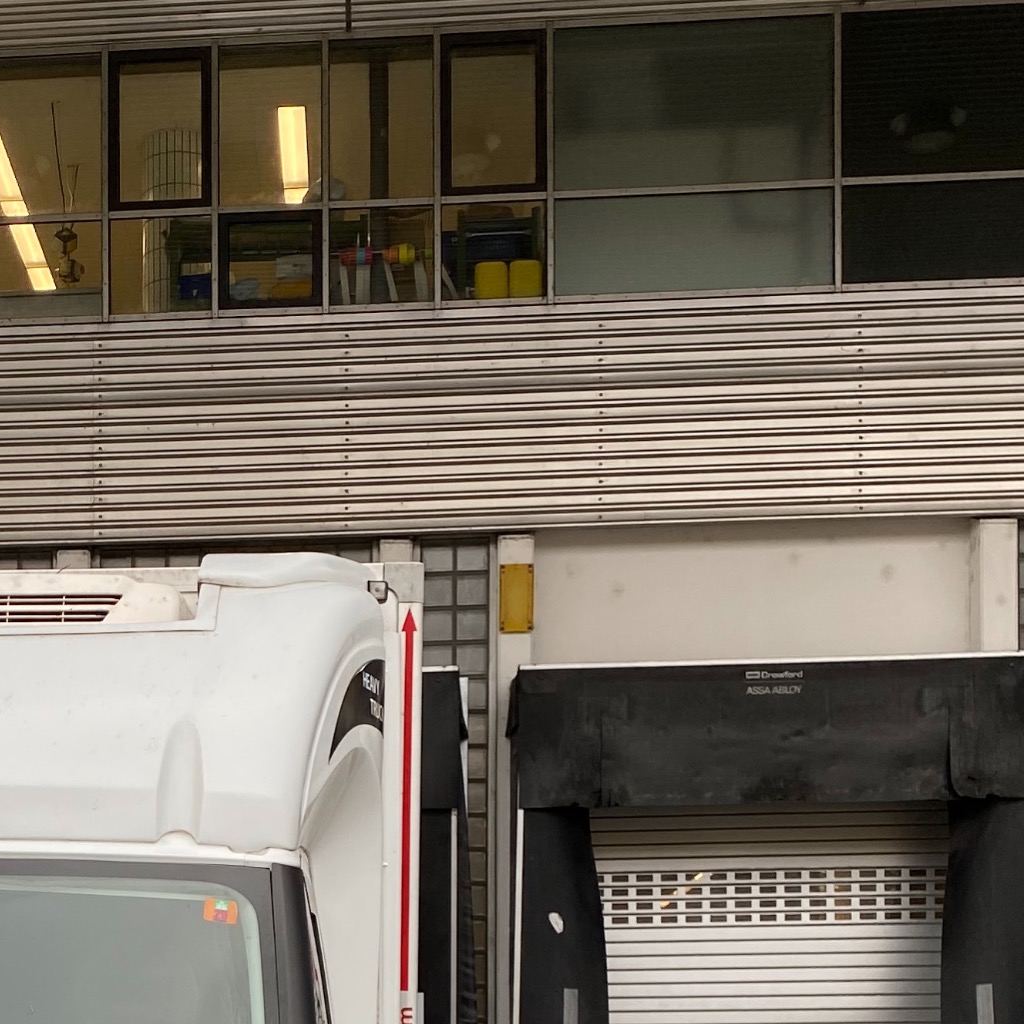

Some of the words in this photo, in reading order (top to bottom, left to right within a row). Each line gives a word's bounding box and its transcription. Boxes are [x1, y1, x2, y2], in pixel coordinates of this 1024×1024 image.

[362, 671, 380, 695] HEAVY
[746, 686, 771, 695] ASSA
[772, 685, 802, 694] ABLOY
